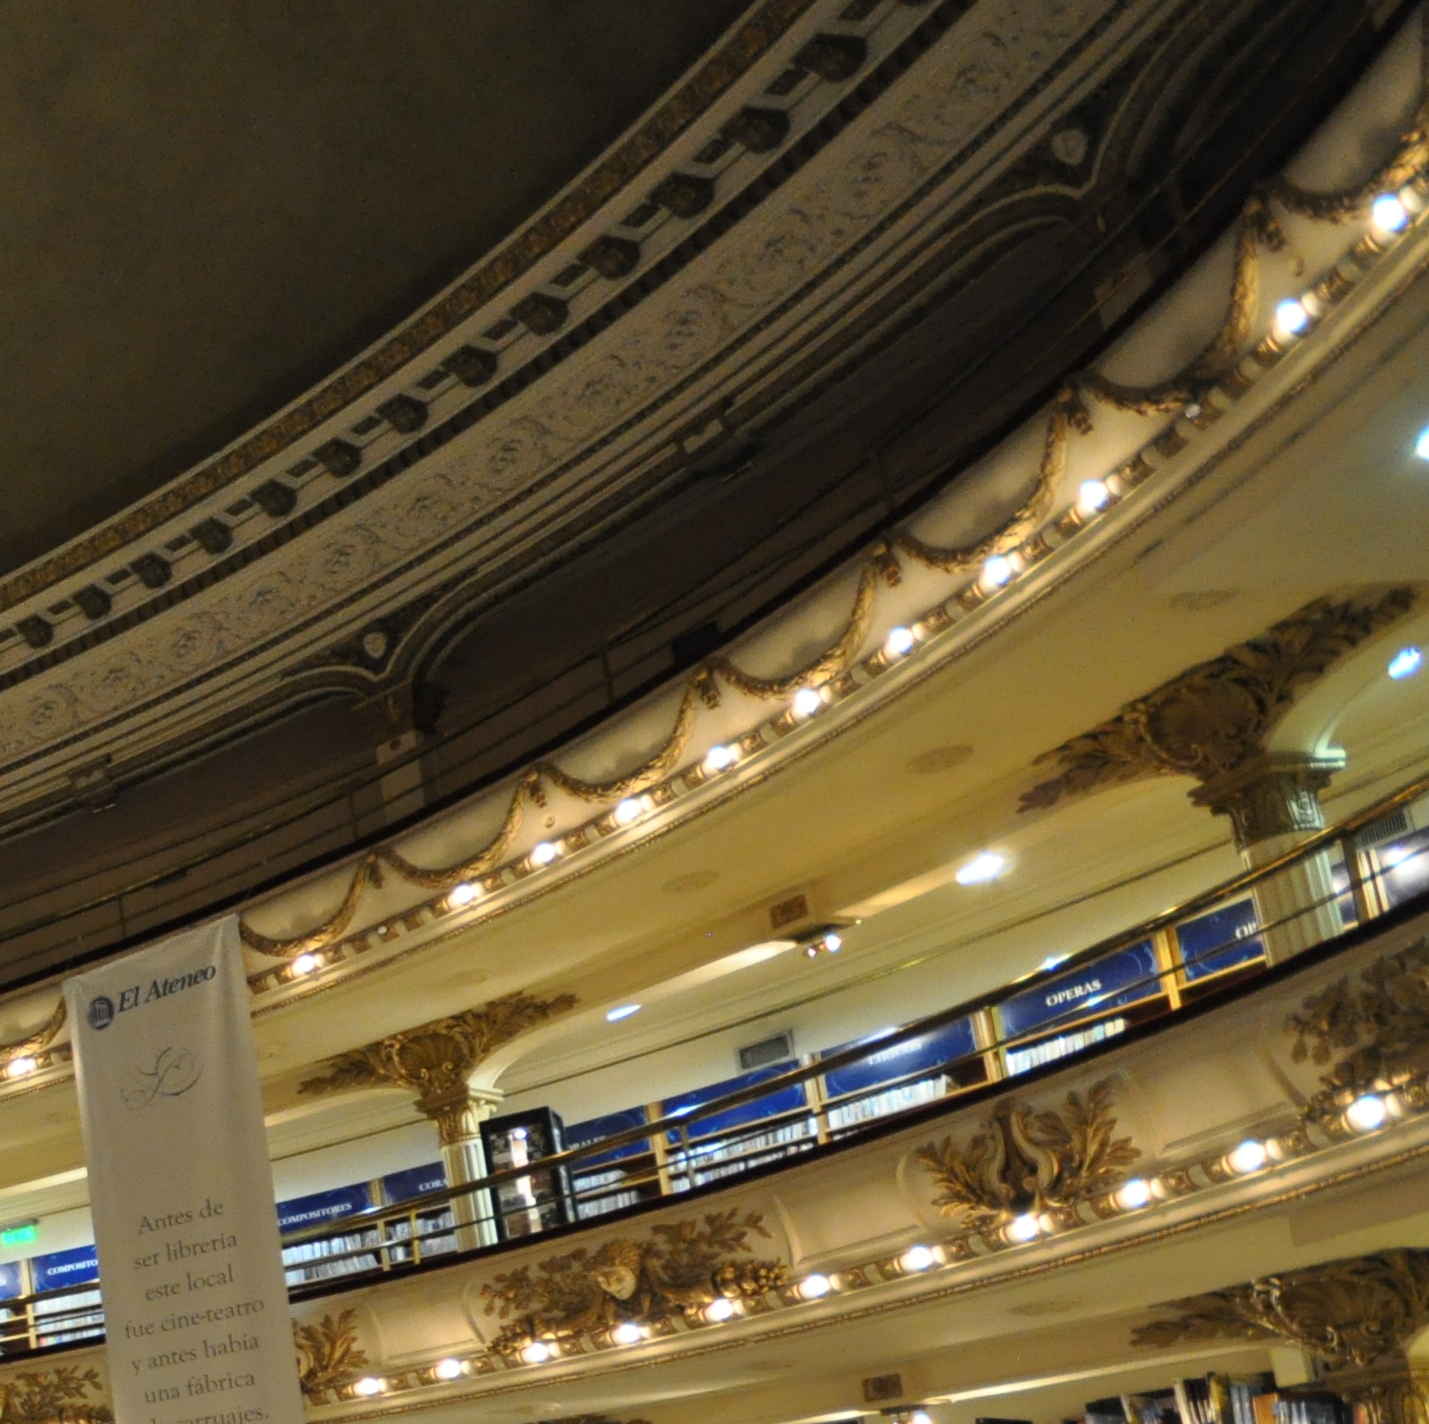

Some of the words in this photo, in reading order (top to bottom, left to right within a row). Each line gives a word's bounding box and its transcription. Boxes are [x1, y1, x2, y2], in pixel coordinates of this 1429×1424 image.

[118, 985, 139, 1013] El
[144, 965, 216, 1003] Ateneo
[1045, 979, 1102, 1007] OPERAS
[138, 1208, 192, 1235] Antes
[199, 1199, 224, 1220] de
[278, 1202, 352, 1227] COMPOSITORES
[134, 1252, 160, 1270] ser
[166, 1233, 238, 1262] librería
[145, 1281, 181, 1301] este
[187, 1264, 234, 1291] local
[125, 1319, 155, 1340] fue
[161, 1300, 265, 1333] cine-teatro
[131, 1359, 143, 1376] y
[148, 1348, 197, 1370] antes
[204, 1334, 259, 1358] había
[145, 1386, 181, 1404] una
[187, 1372, 256, 1398] fábrica
